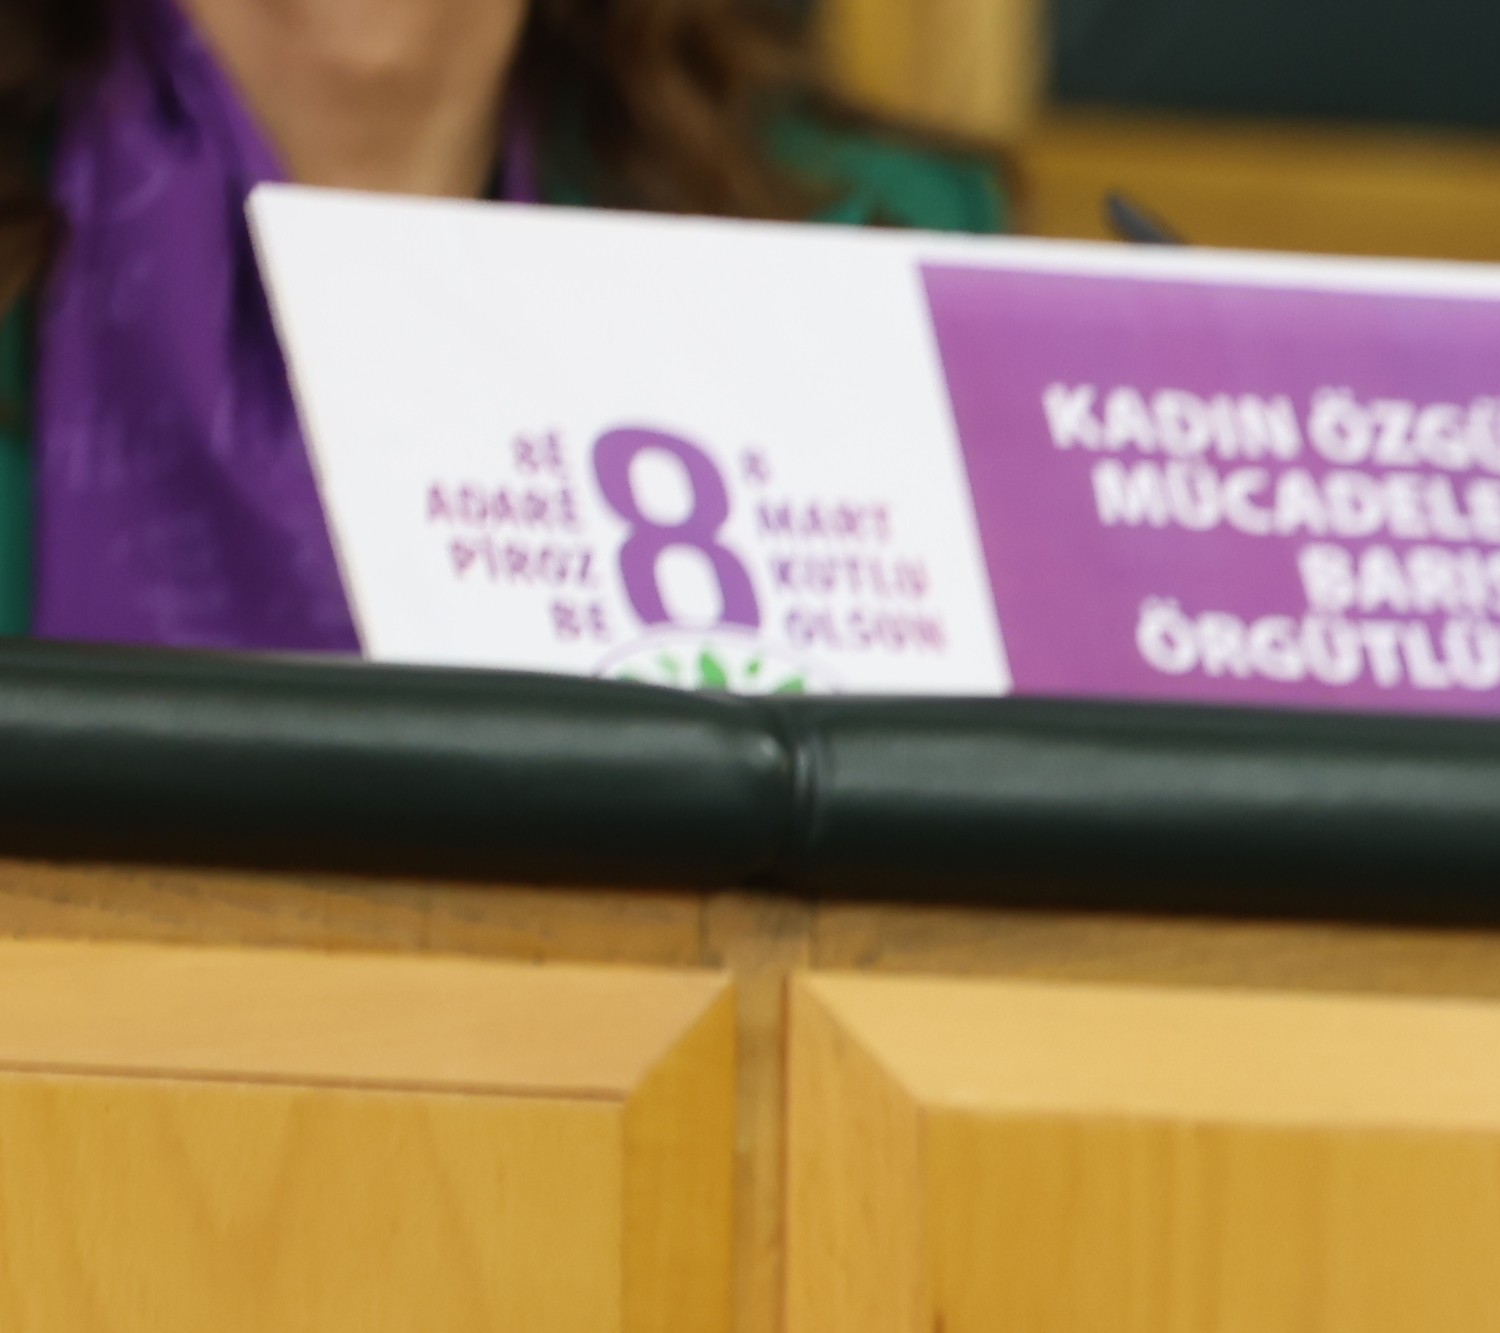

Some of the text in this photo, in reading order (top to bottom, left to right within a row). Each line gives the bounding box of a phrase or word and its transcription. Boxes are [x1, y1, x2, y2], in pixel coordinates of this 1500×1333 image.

[1045, 385, 1299, 460] KADIN
[757, 502, 890, 541] MART
[773, 556, 928, 598] KUTLU
[785, 608, 947, 651] OLSUN
